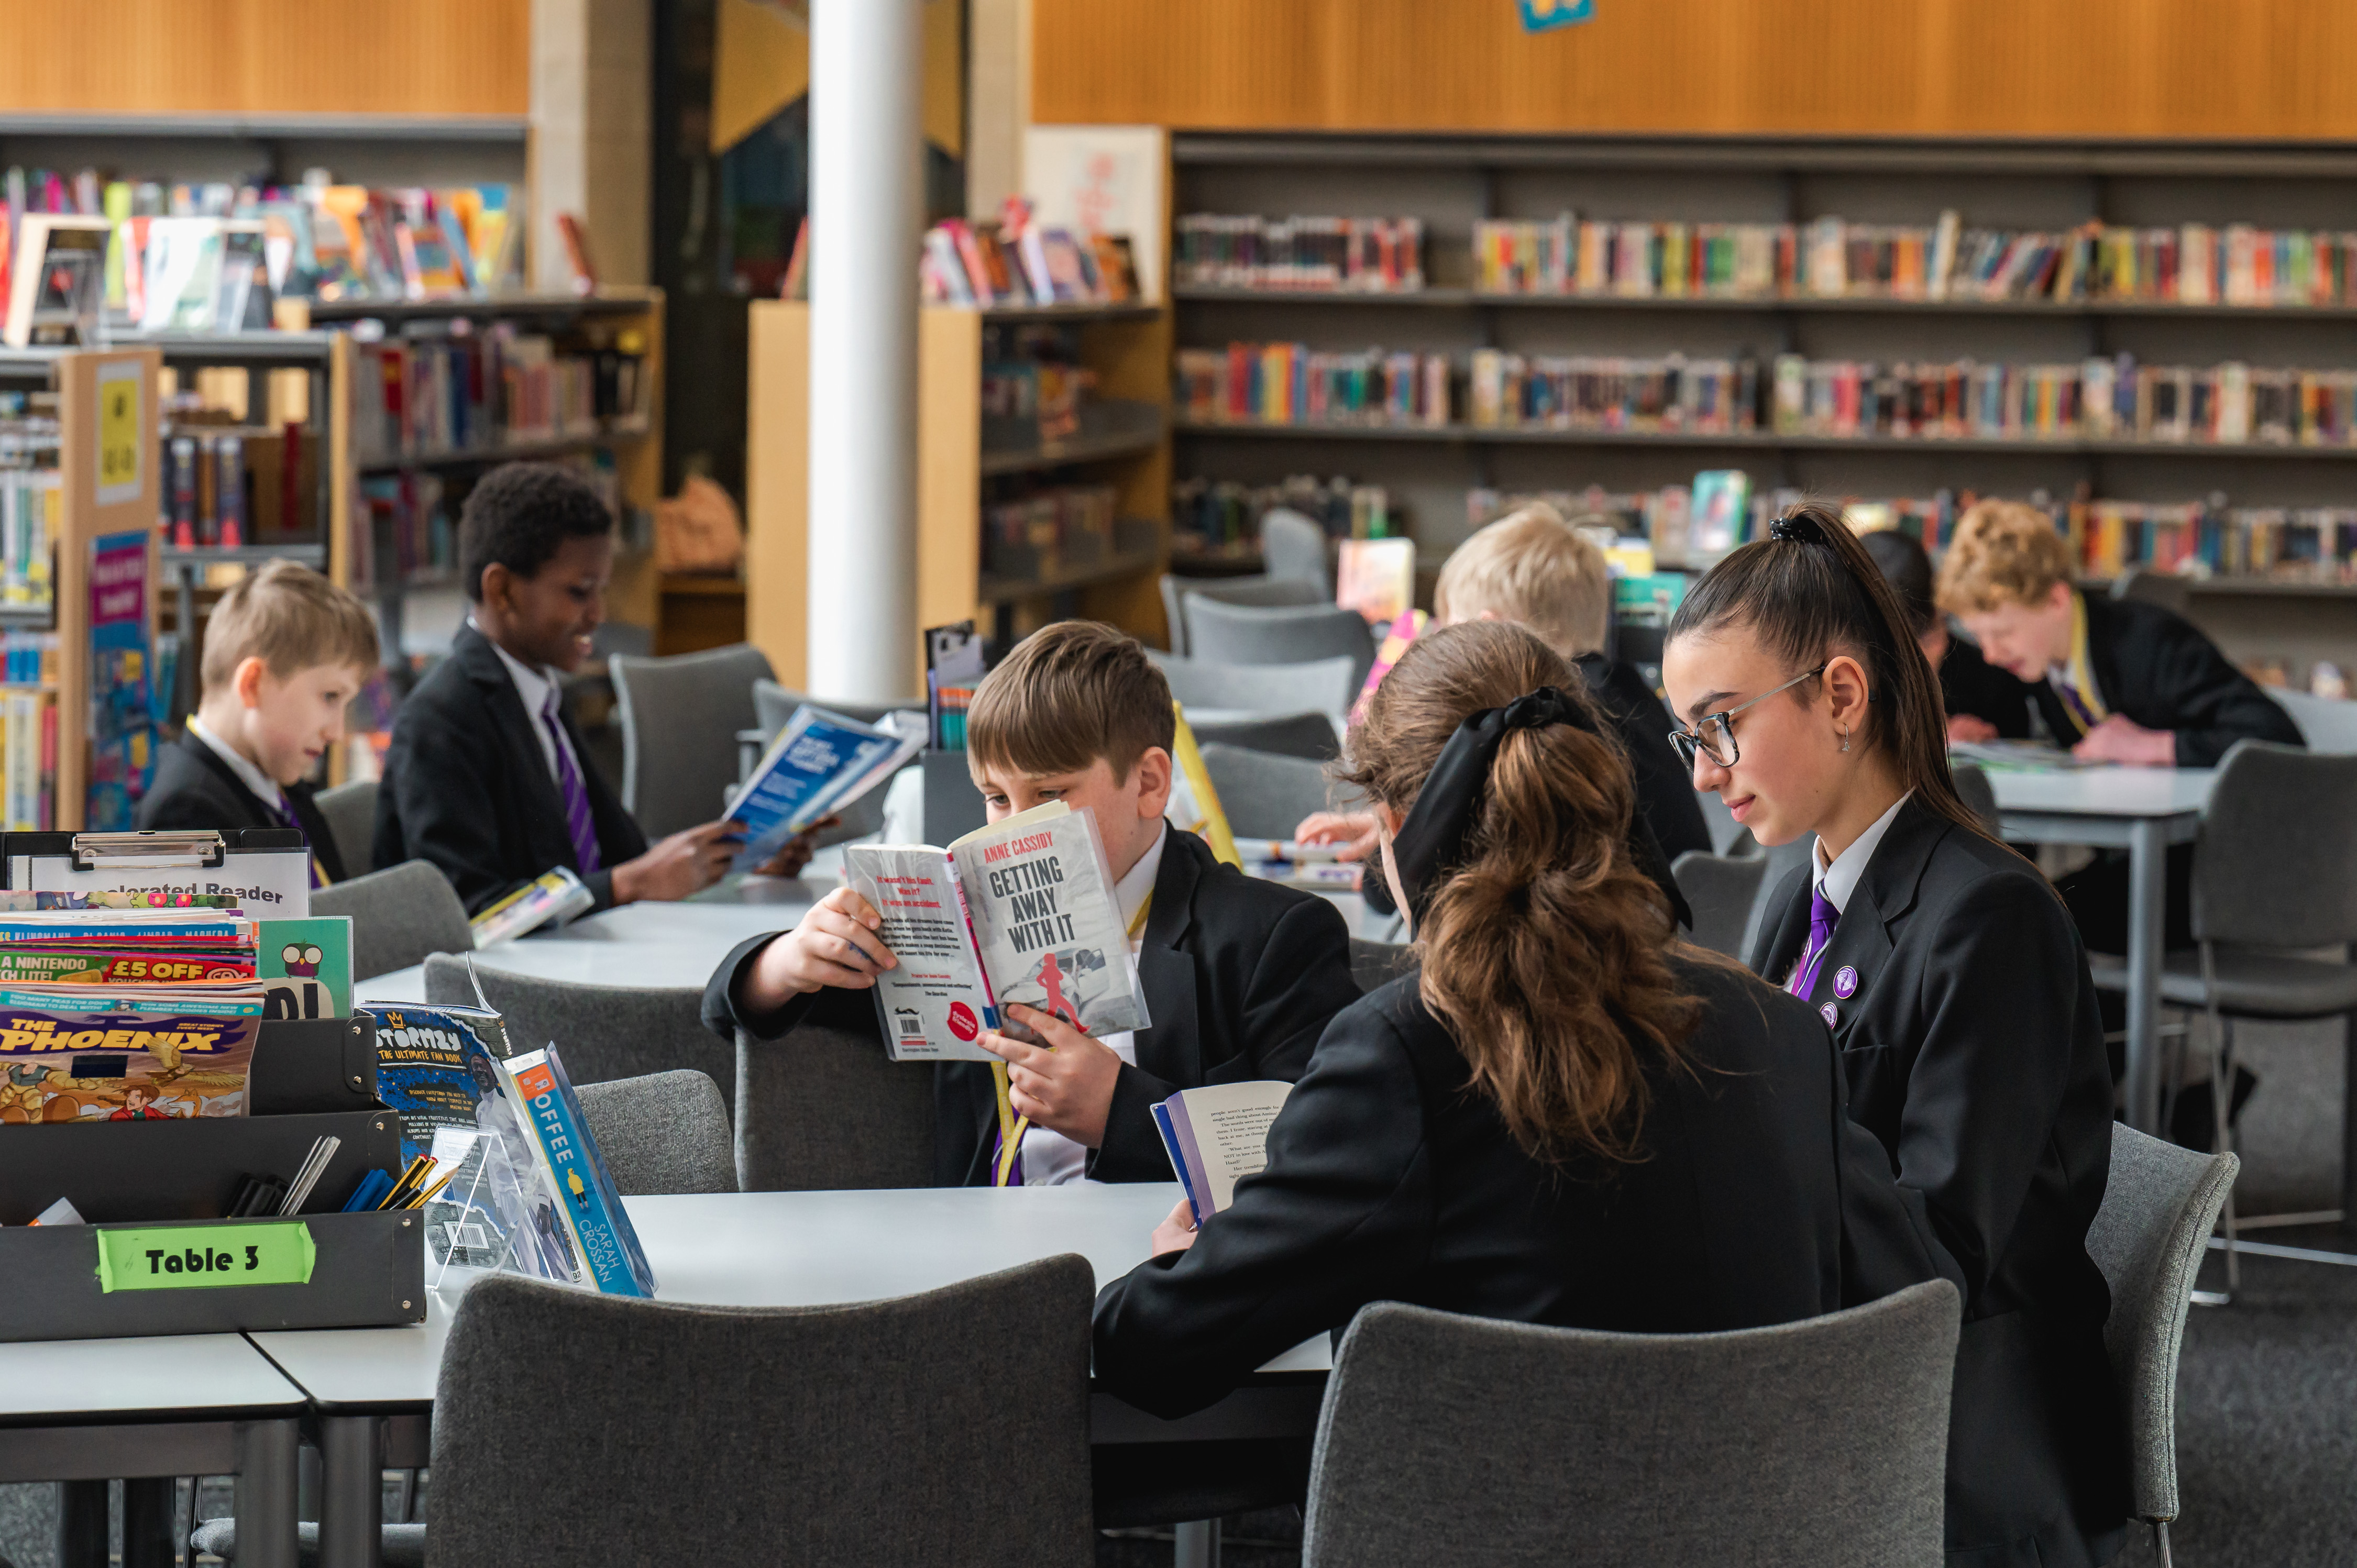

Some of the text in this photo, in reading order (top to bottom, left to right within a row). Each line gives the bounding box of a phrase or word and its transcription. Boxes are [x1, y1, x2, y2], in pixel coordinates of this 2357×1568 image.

[984, 831, 1053, 864] ANNE CASSIDY
[989, 856, 1064, 898] GETTING
[206, 883, 283, 904] Reader
[1011, 887, 1057, 923] AWAY
[1007, 913, 1075, 954] WITH IT
[1, 956, 87, 970] A NINTENDO
[21, 970, 53, 981] LITE!
[113, 961, 147, 977] £5
[152, 963, 203, 979] OFF
[11, 1019, 57, 1031] THE
[0, 1029, 221, 1051] PHOENIX
[376, 1027, 461, 1051] STORMZY
[378, 1050, 462, 1064] THE ULTIMATE FAN BOOK
[535, 1094, 574, 1164] OFFEE
[579, 1220, 612, 1283] CROSSAN
[594, 1224, 620, 1268] SARAH
[146, 1245, 258, 1274] Table 3
